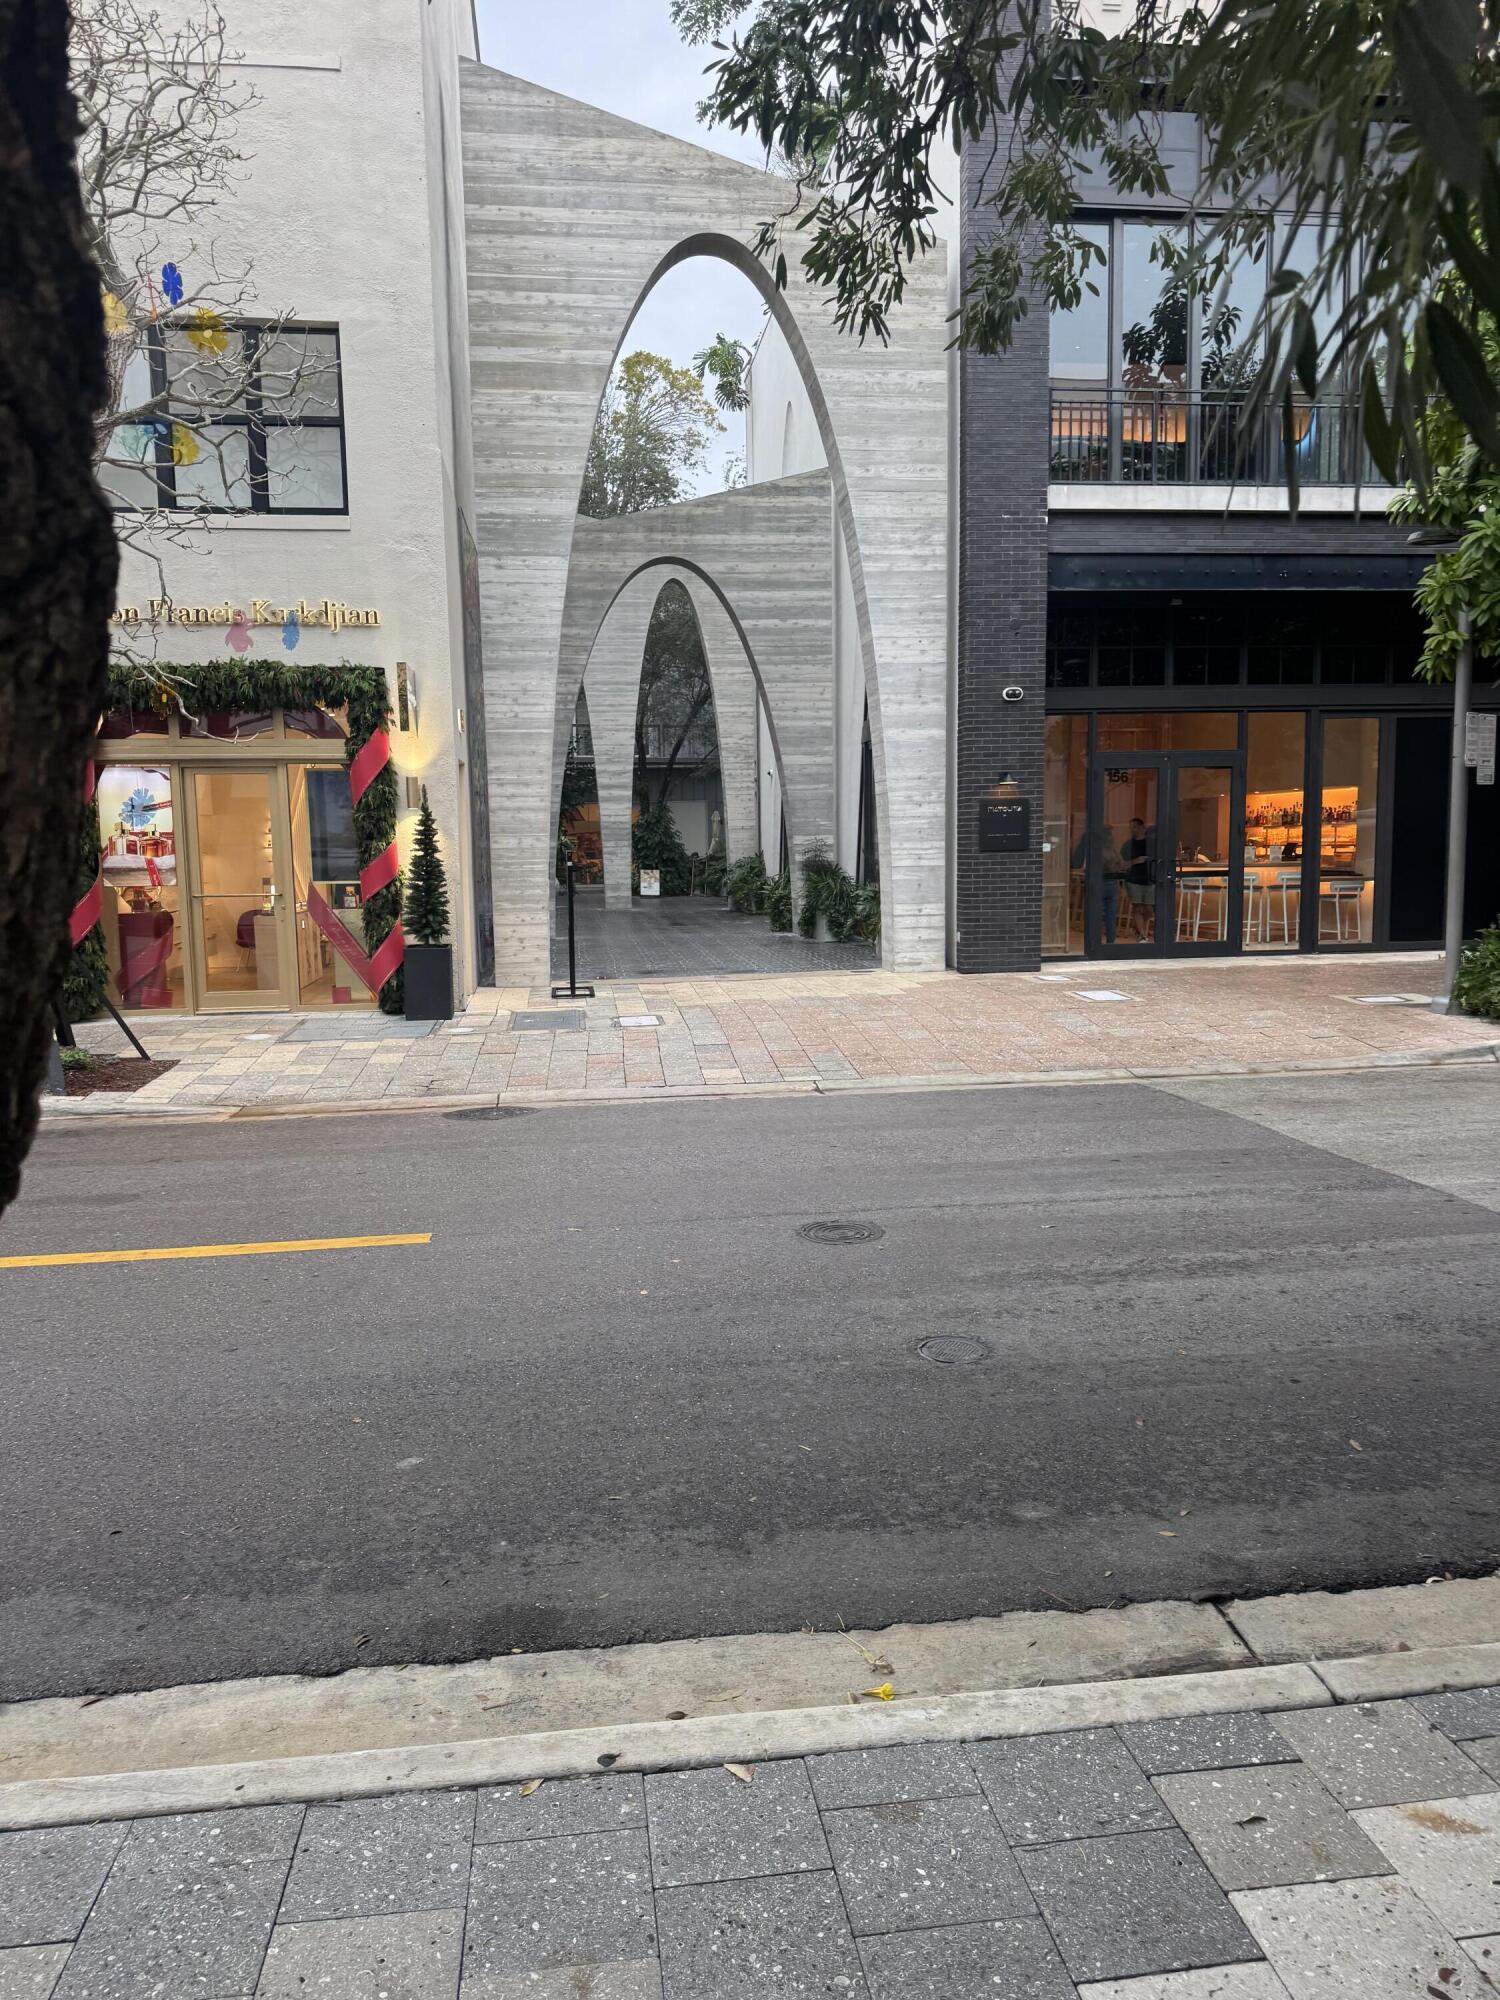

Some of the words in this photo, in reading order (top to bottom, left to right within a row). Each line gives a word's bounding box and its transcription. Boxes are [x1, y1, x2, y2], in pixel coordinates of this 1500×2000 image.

[147, 599, 244, 624] Francis
[250, 599, 381, 634] Kurkdjian
[1108, 771, 1129, 784] 156
